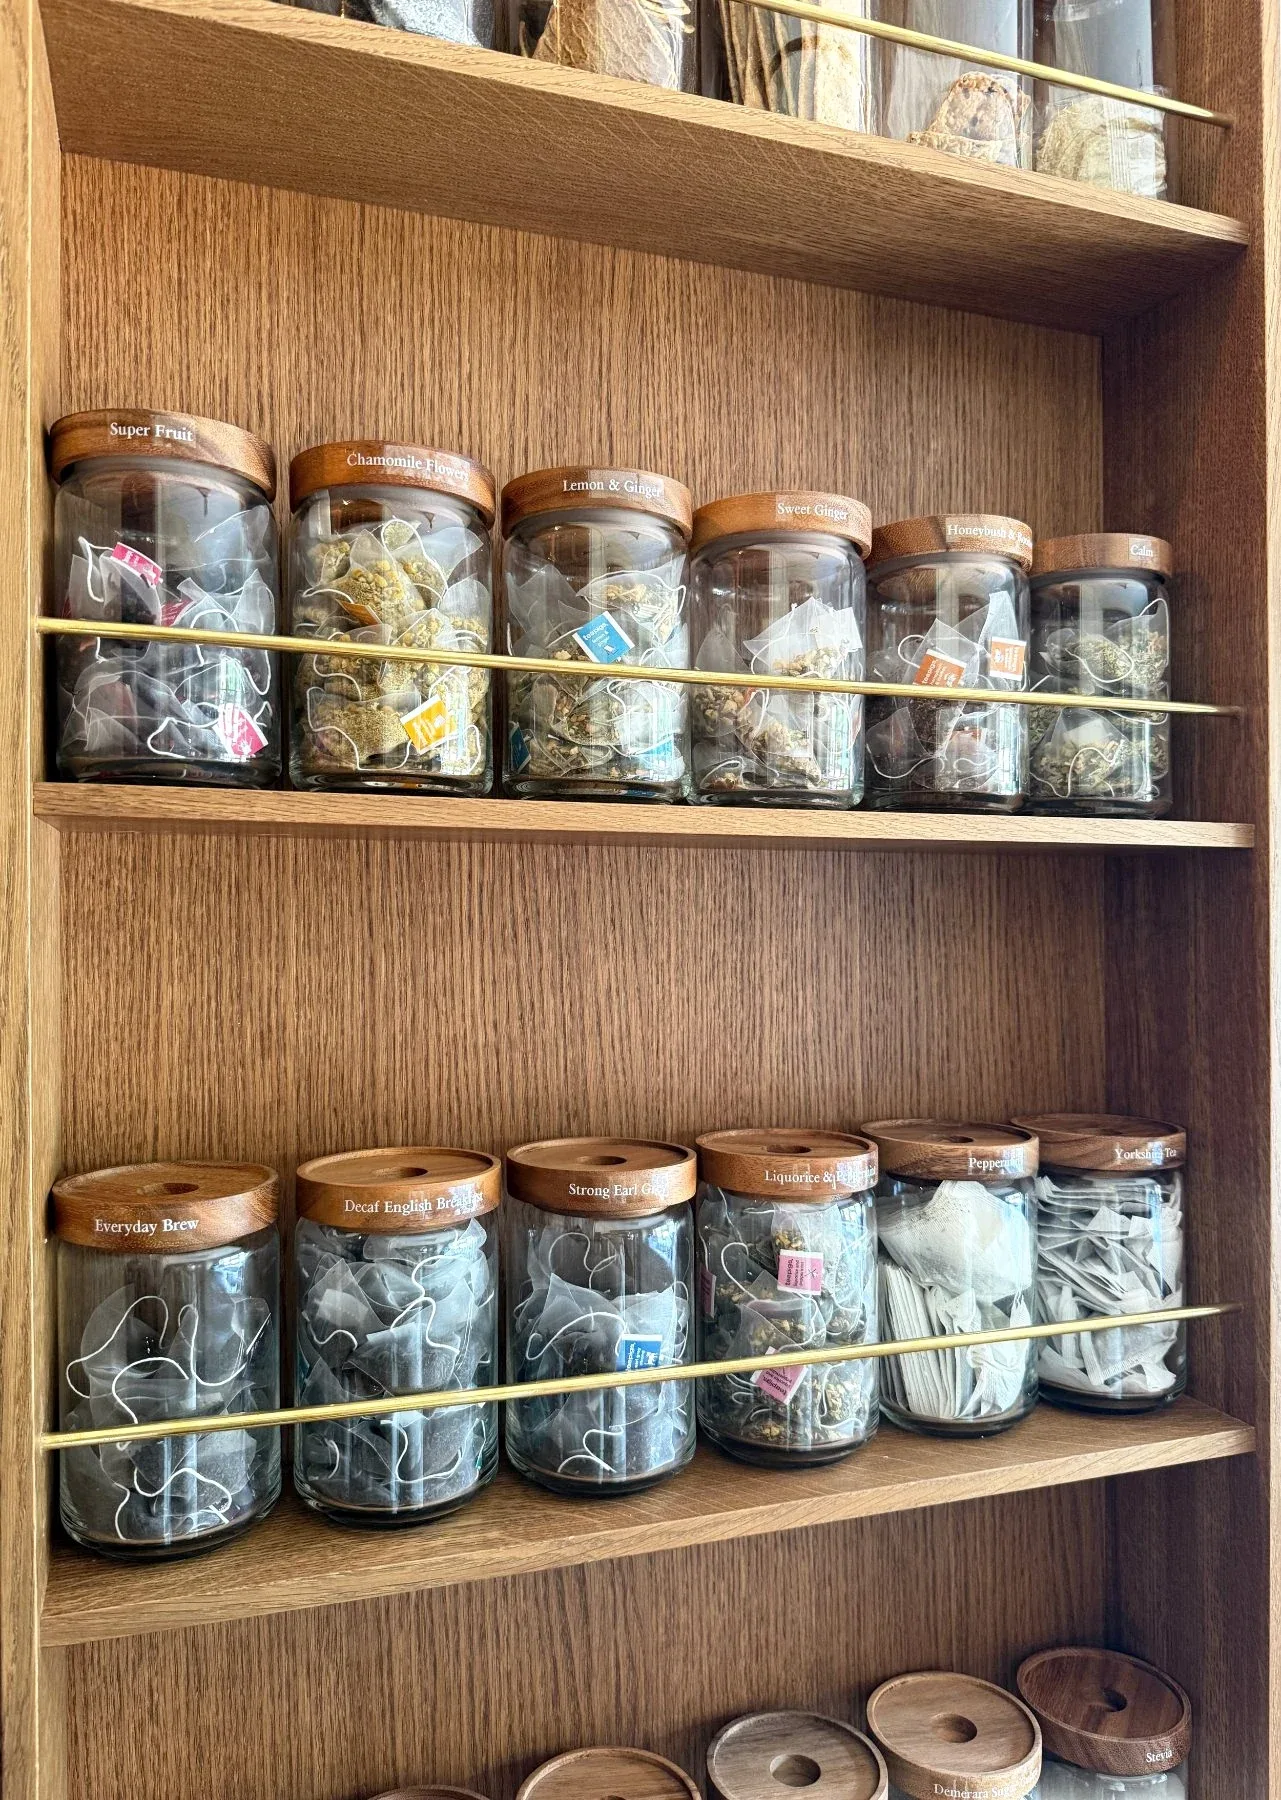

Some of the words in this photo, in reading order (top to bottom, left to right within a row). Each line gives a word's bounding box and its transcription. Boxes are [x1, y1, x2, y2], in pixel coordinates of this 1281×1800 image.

[110, 422, 151, 440] Super
[155, 424, 195, 442] Fruit
[347, 452, 423, 470] Chamomile
[563, 480, 604, 492] Lemon
[608, 479, 620, 491] &
[624, 480, 662, 499] Ginger
[777, 503, 812, 515] Sweet
[814, 504, 848, 522] Ginger
[947, 524, 1006, 538] Honeybush
[1130, 544, 1154, 557] Calm
[1165, 1147, 1177, 1158] Tea
[765, 1170, 820, 1185] Liquorice
[823, 1171, 832, 1182] &
[569, 1183, 610, 1199] Strong
[614, 1184, 637, 1196] Earl
[345, 1199, 379, 1213] Decaf
[384, 1200, 432, 1215] English
[95, 1219, 158, 1236] Everyday
[162, 1218, 200, 1232] Brew
[1146, 1748, 1173, 1763] Stevia
[934, 1783, 989, 1799] Demerara
[991, 1782, 1019, 1798] Sug
